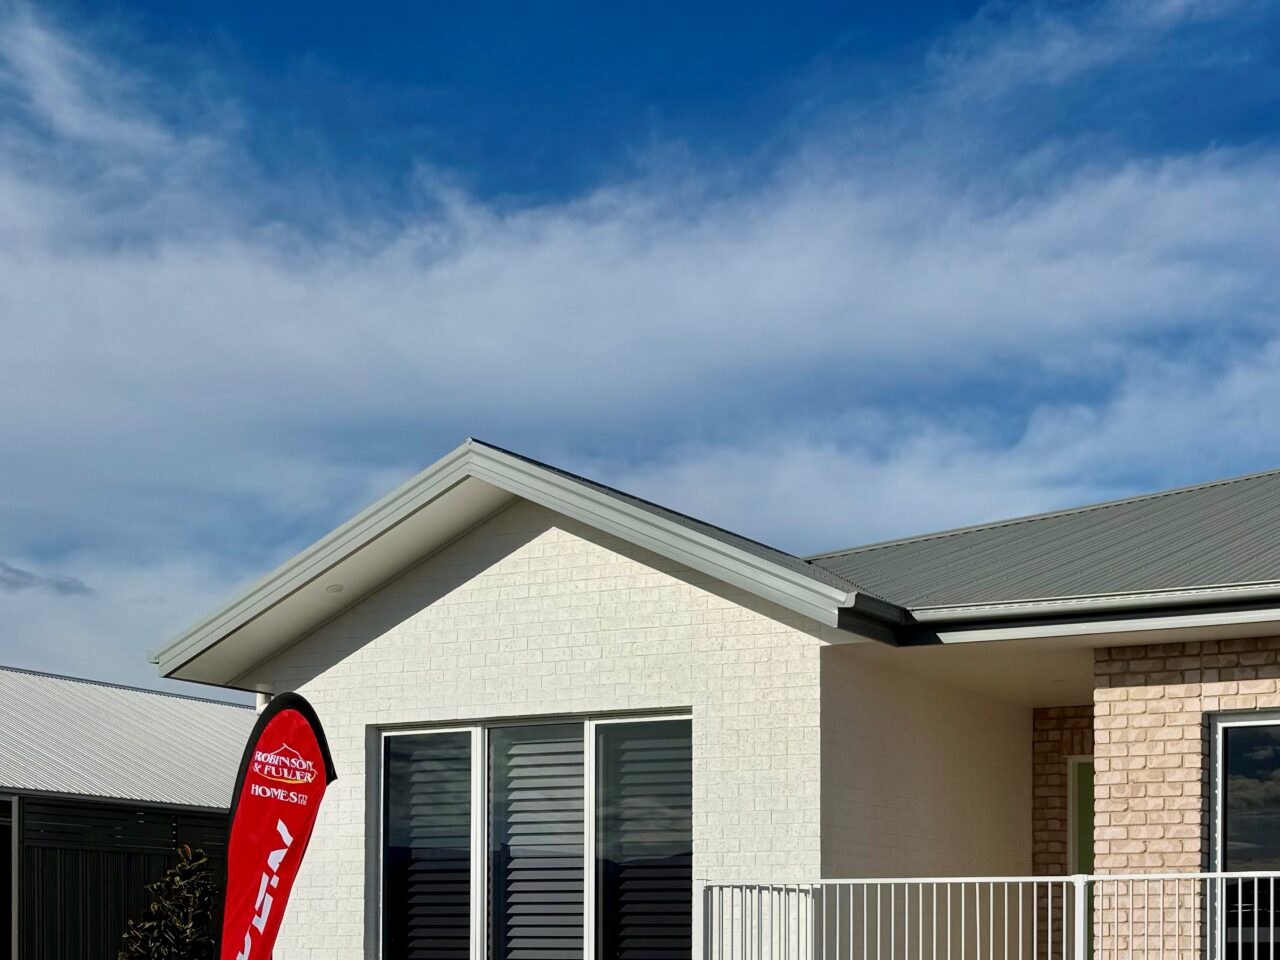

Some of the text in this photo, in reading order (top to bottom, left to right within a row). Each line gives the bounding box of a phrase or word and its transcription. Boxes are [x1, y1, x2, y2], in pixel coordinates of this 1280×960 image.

[254, 751, 314, 771] ROBINSON
[254, 762, 313, 783] & FULLER
[251, 783, 298, 803] HOMES
